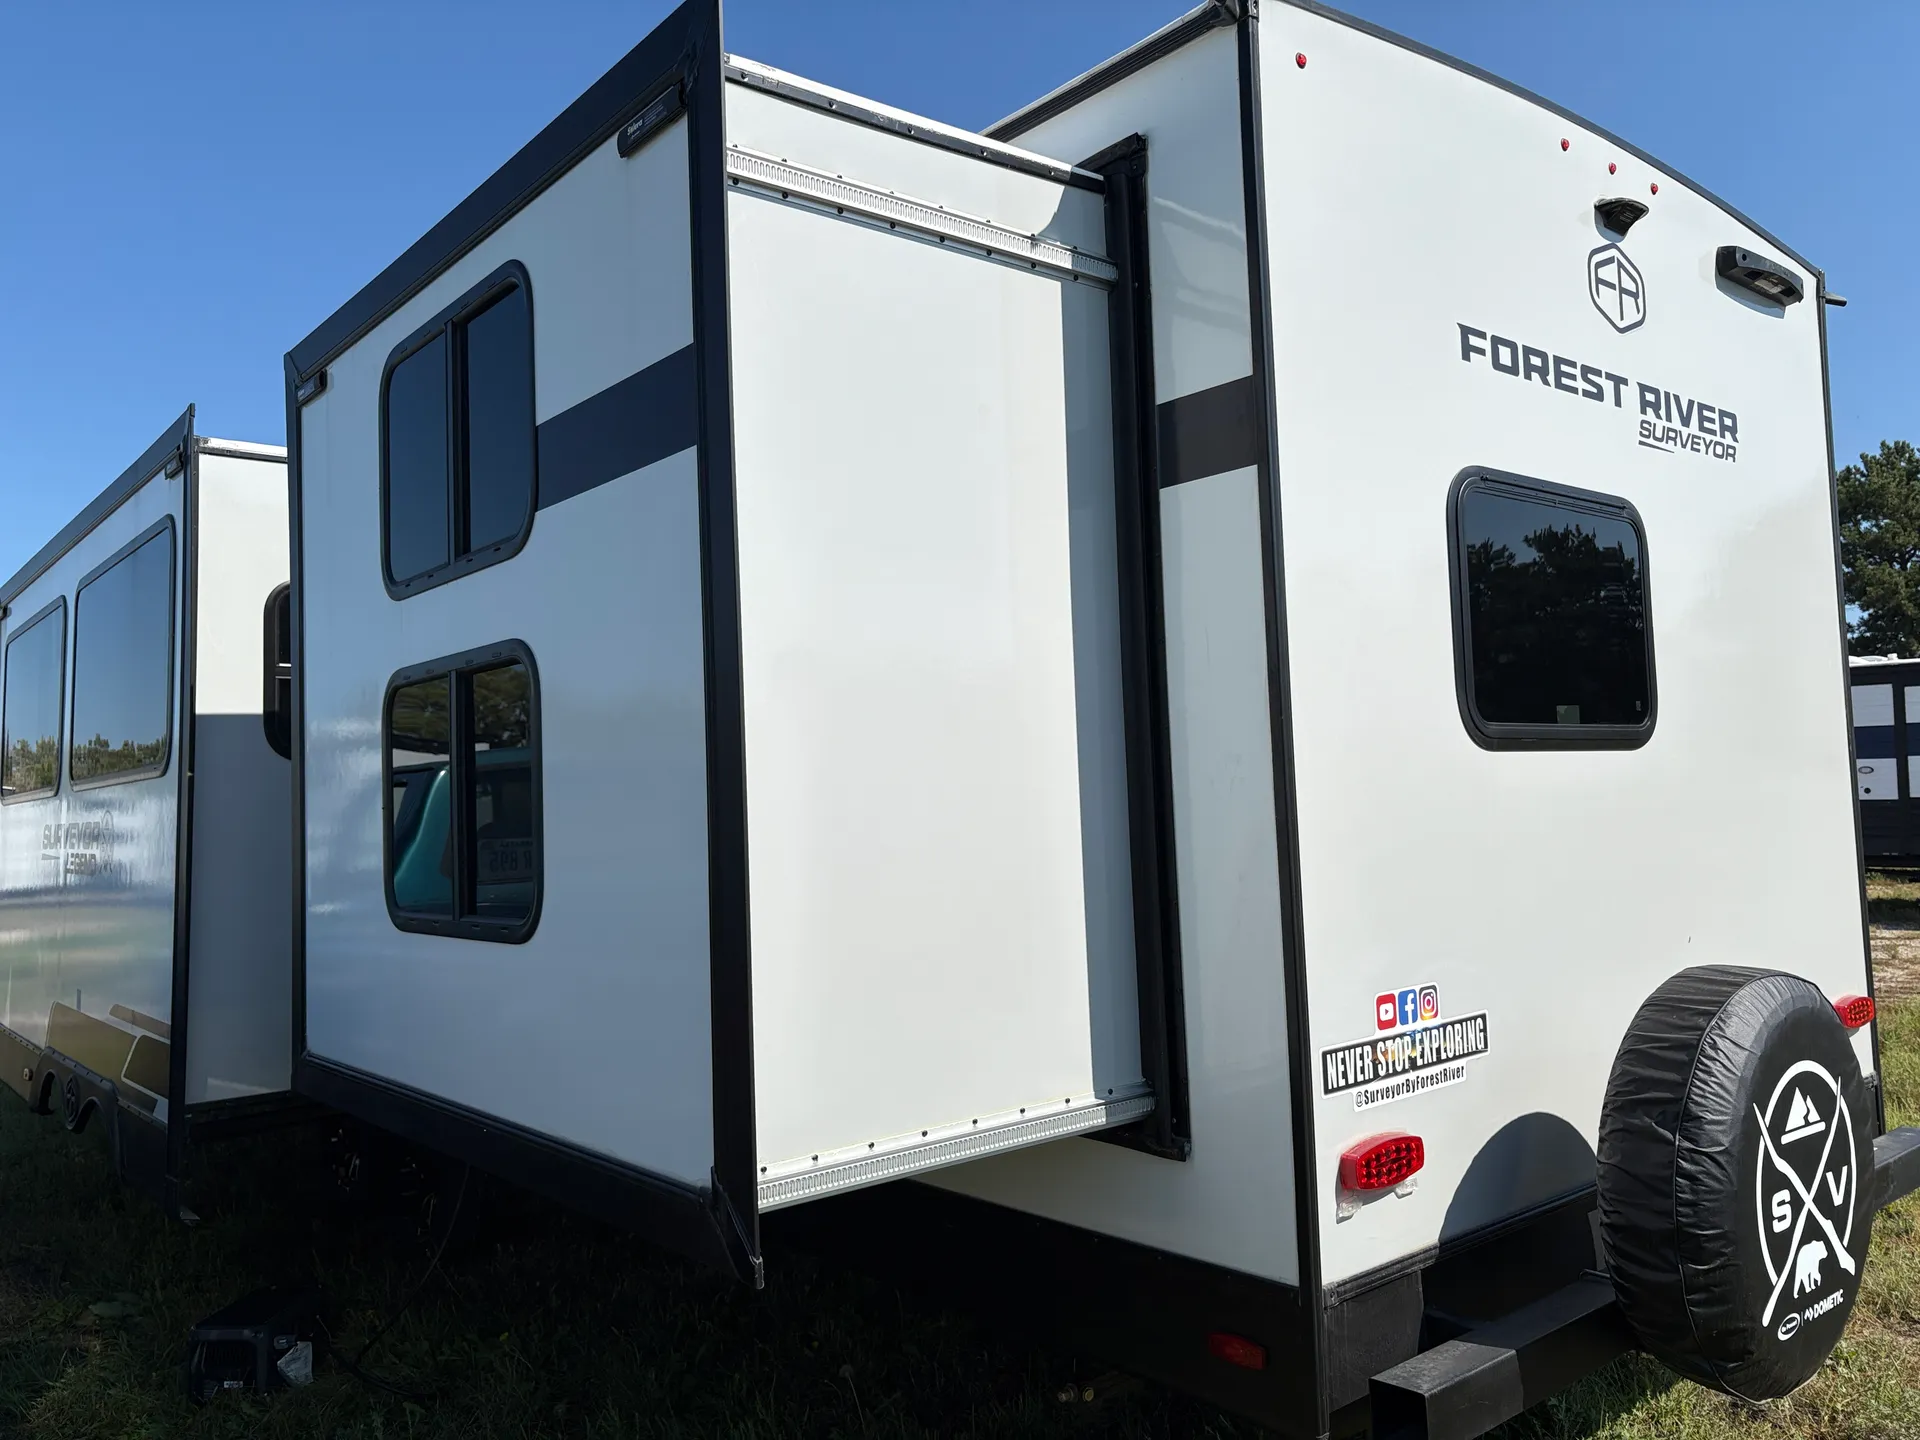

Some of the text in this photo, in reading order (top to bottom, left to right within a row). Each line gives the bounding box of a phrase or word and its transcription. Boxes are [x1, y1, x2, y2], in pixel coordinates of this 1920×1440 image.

[1457, 322, 1739, 443] FOREST RIVER
[1639, 419, 1737, 463] SURVEYOR
[42, 821, 100, 850] SURVEYOR
[1326, 1017, 1486, 1090] NEVER STOP EXPLORING
[1355, 1065, 1465, 1108] @SurveyorByForestRiver
[1771, 1165, 1848, 1233] S V
[1813, 1288, 1844, 1319] DOMETIC
